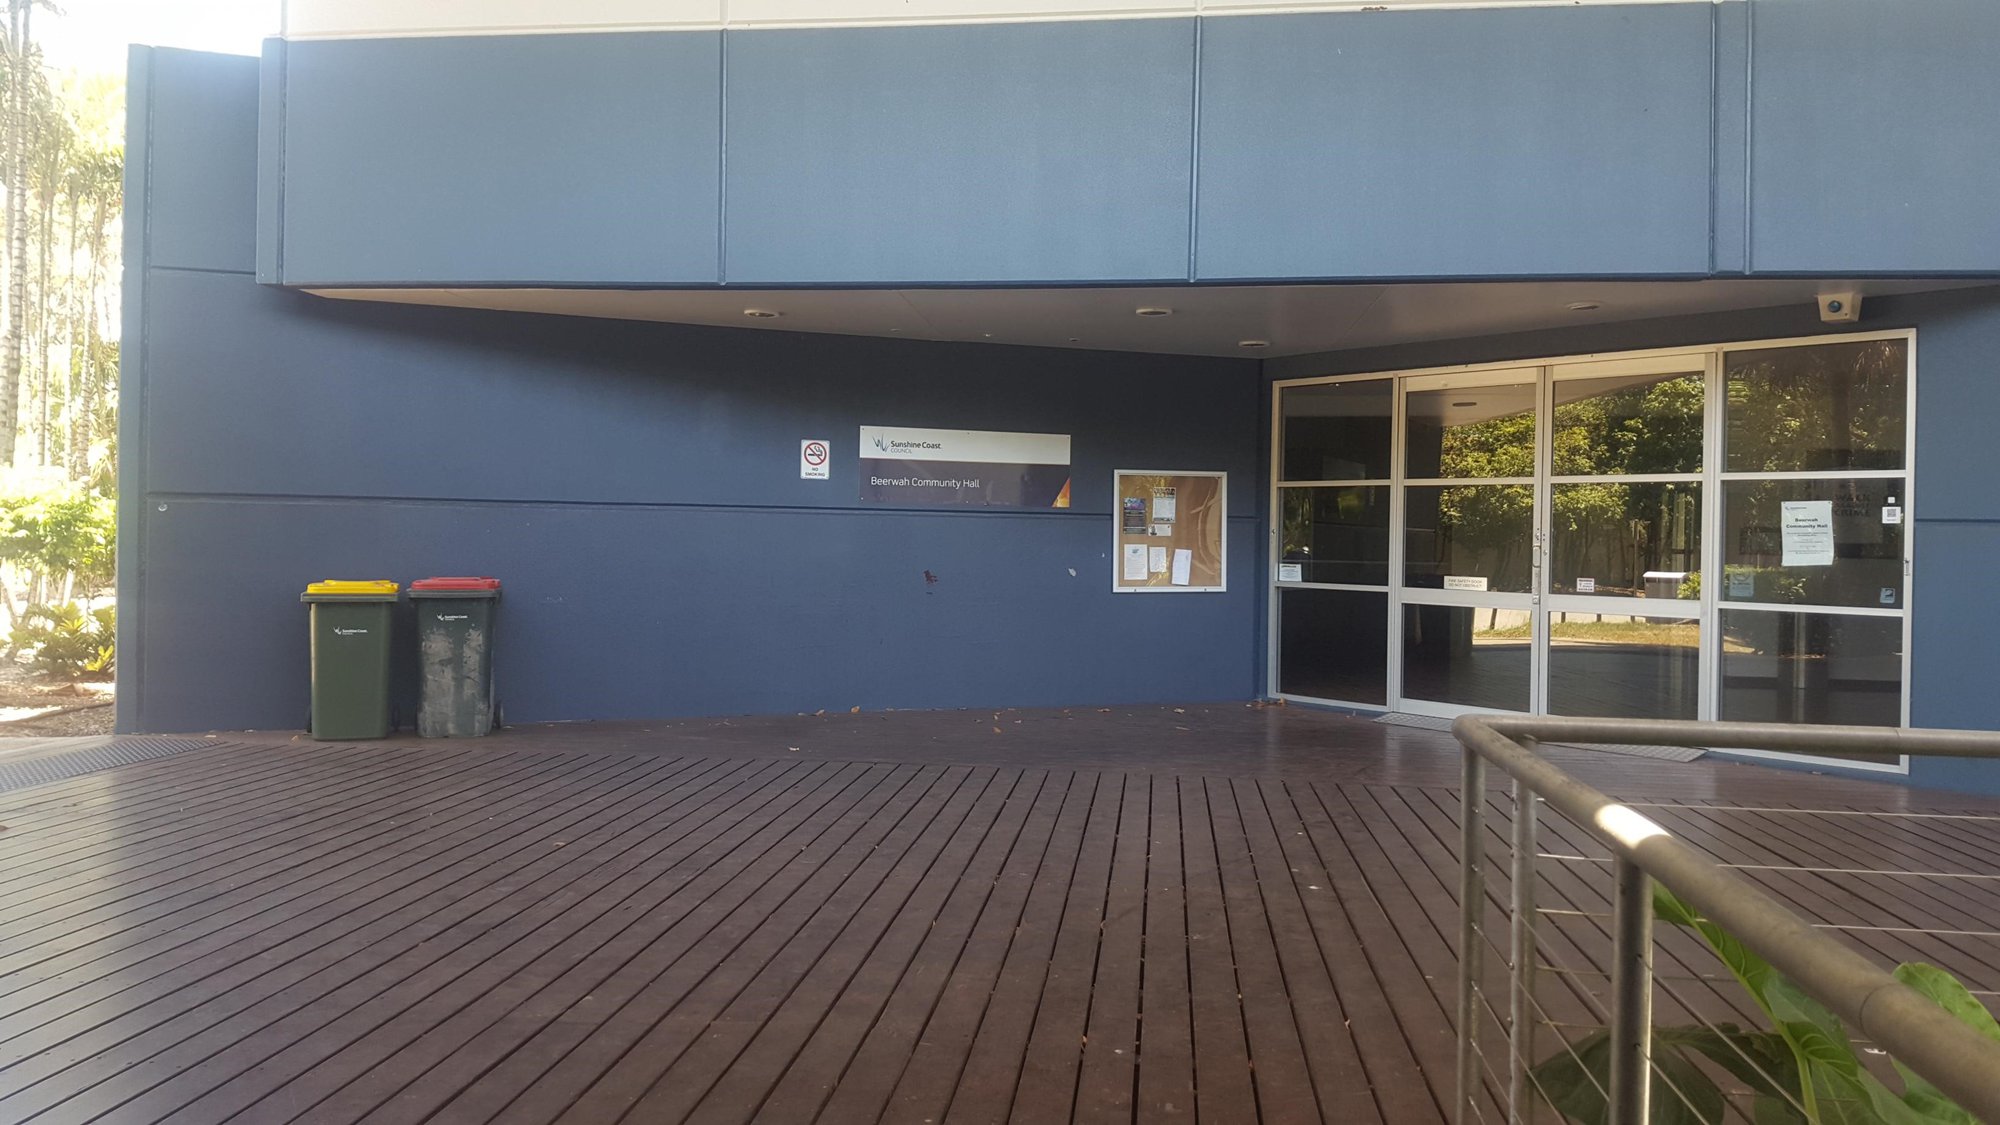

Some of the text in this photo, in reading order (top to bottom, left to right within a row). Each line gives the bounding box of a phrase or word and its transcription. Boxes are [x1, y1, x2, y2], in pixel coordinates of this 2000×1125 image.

[890, 440, 942, 449] Sunshine Coast
[871, 476, 980, 490] Beerwah Community Hall
